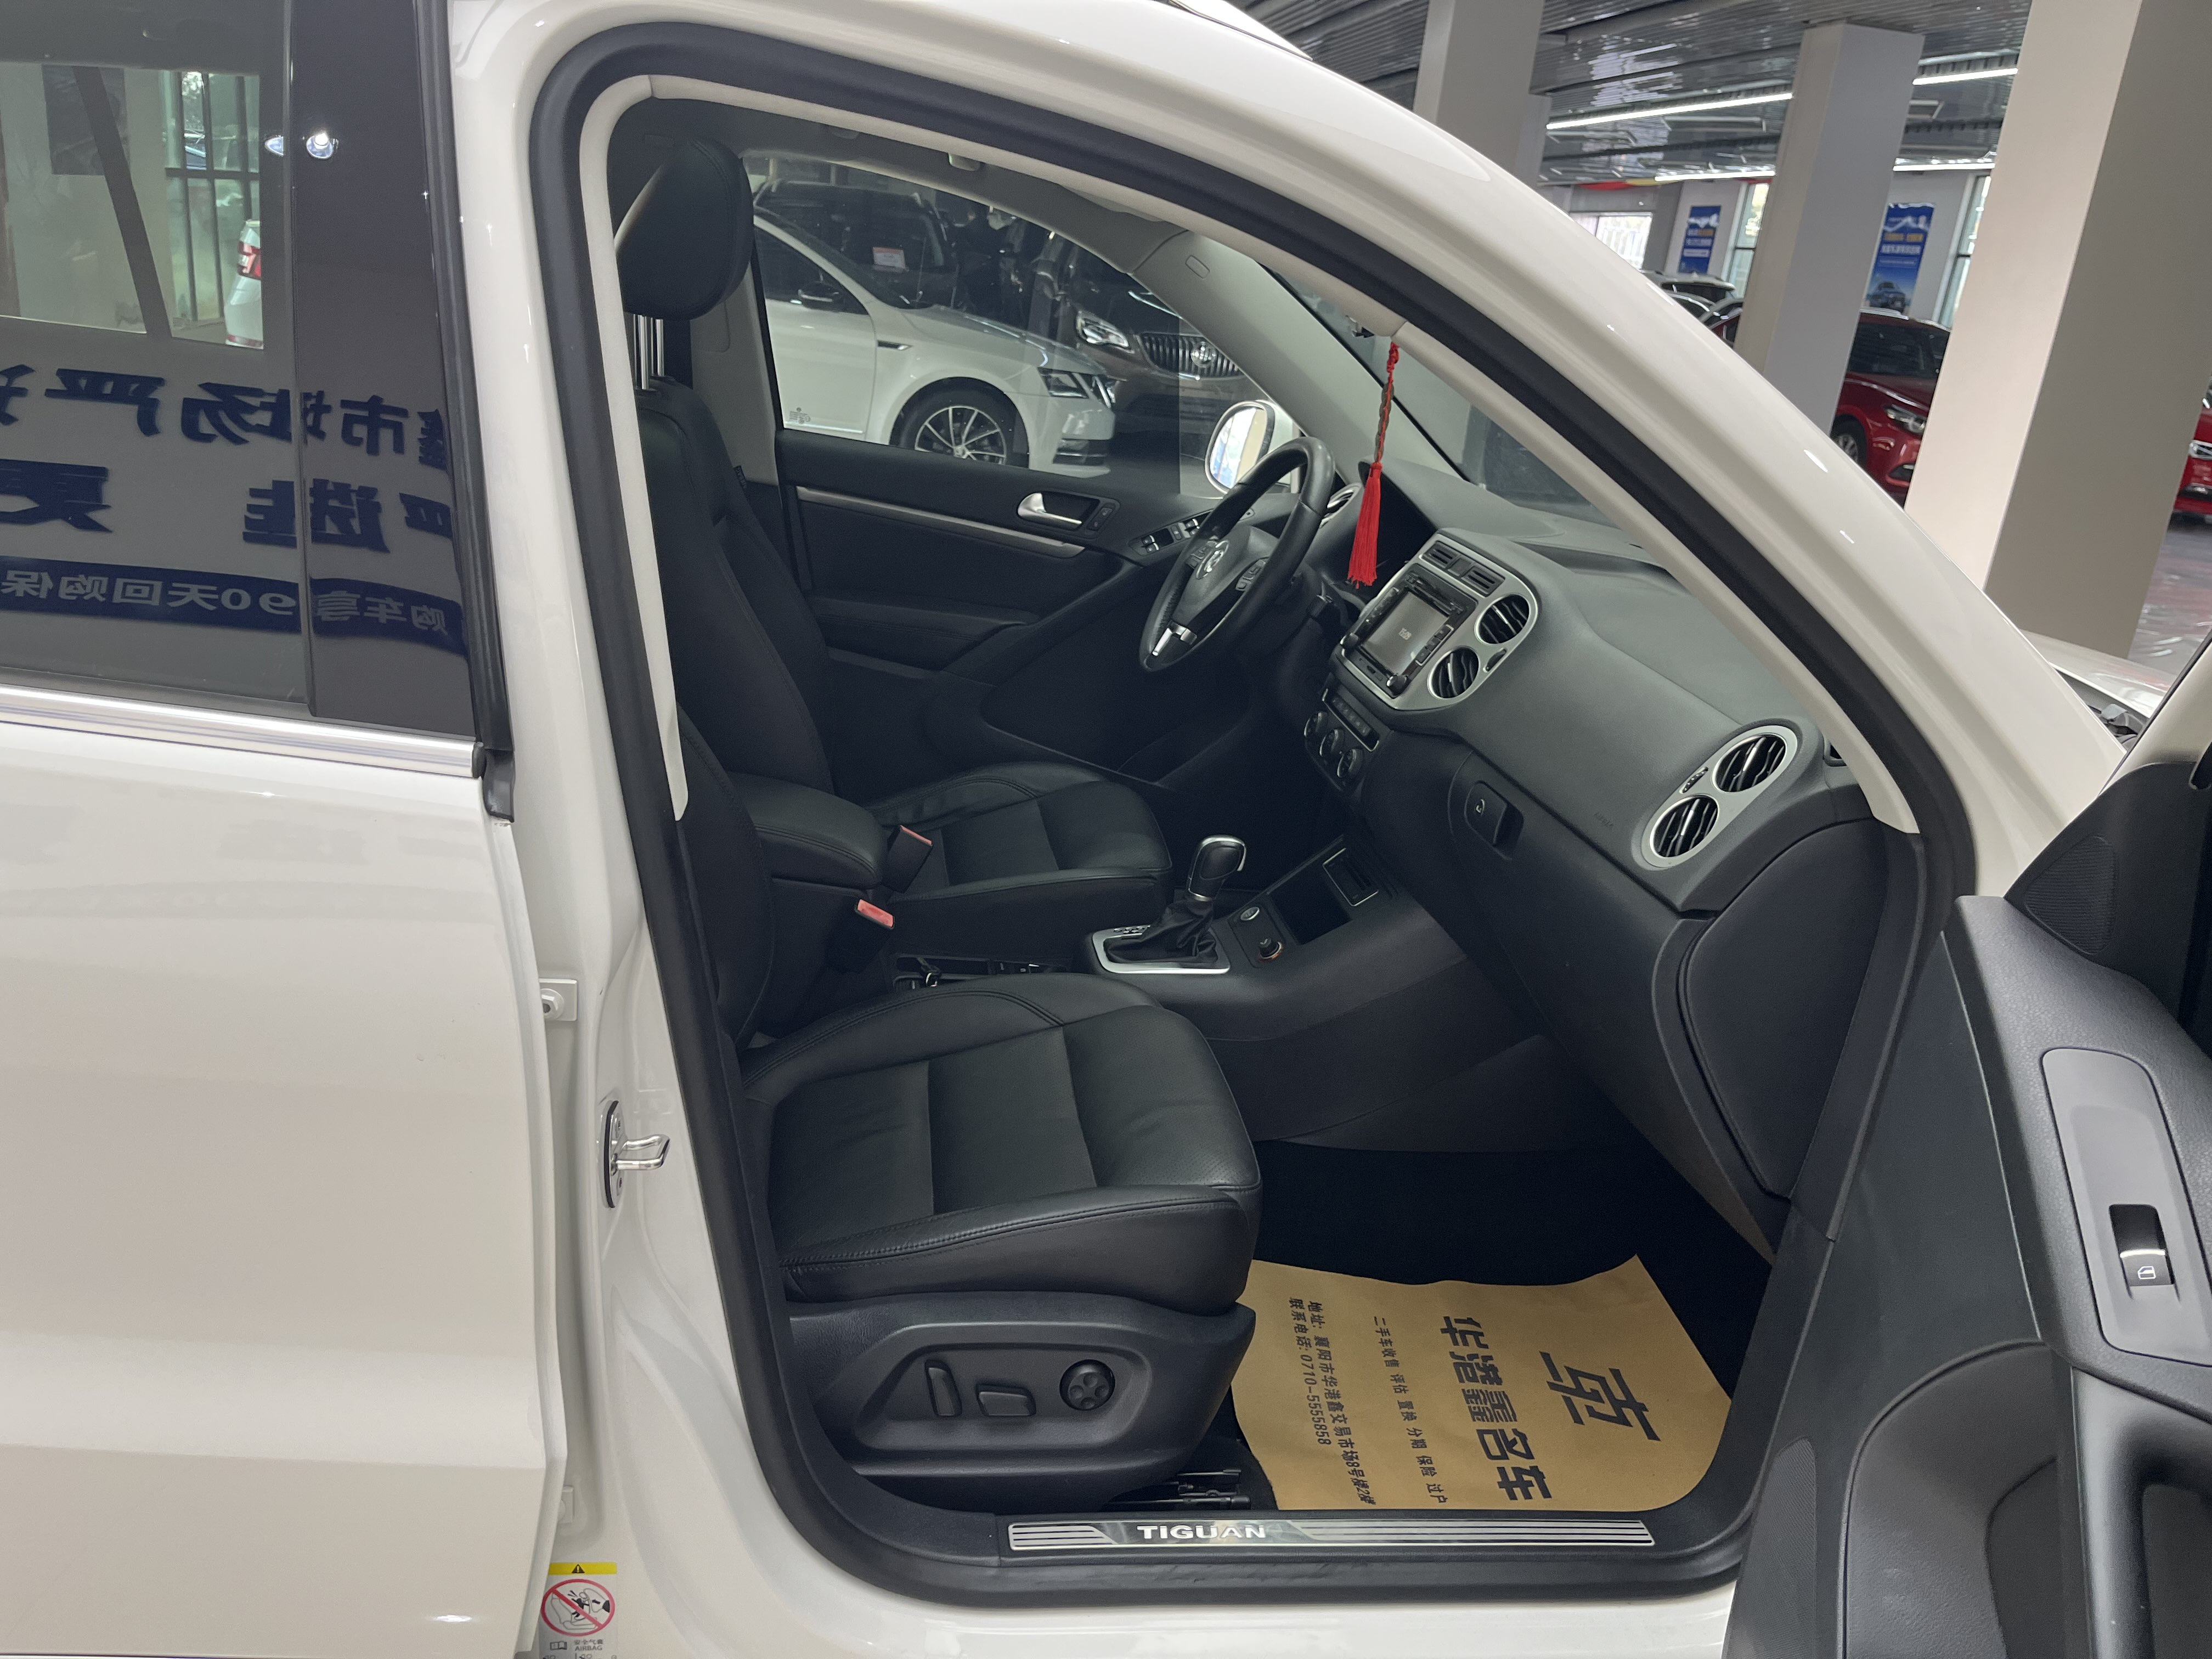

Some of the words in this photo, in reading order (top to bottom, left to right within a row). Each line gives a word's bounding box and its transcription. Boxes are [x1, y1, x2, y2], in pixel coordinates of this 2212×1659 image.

[1374, 1316, 1400, 1368] 二手车收售
[1390, 1374, 1409, 1394] 评估
[1397, 1400, 1418, 1421] 置换
[1440, 1316, 1552, 1501] 华港鑫名车
[1406, 1427, 1427, 1449] 分期
[1416, 1455, 1437, 1477] 保险
[1426, 1483, 1448, 1503] 过户
[1137, 1525, 1266, 1539] TIGUAN
